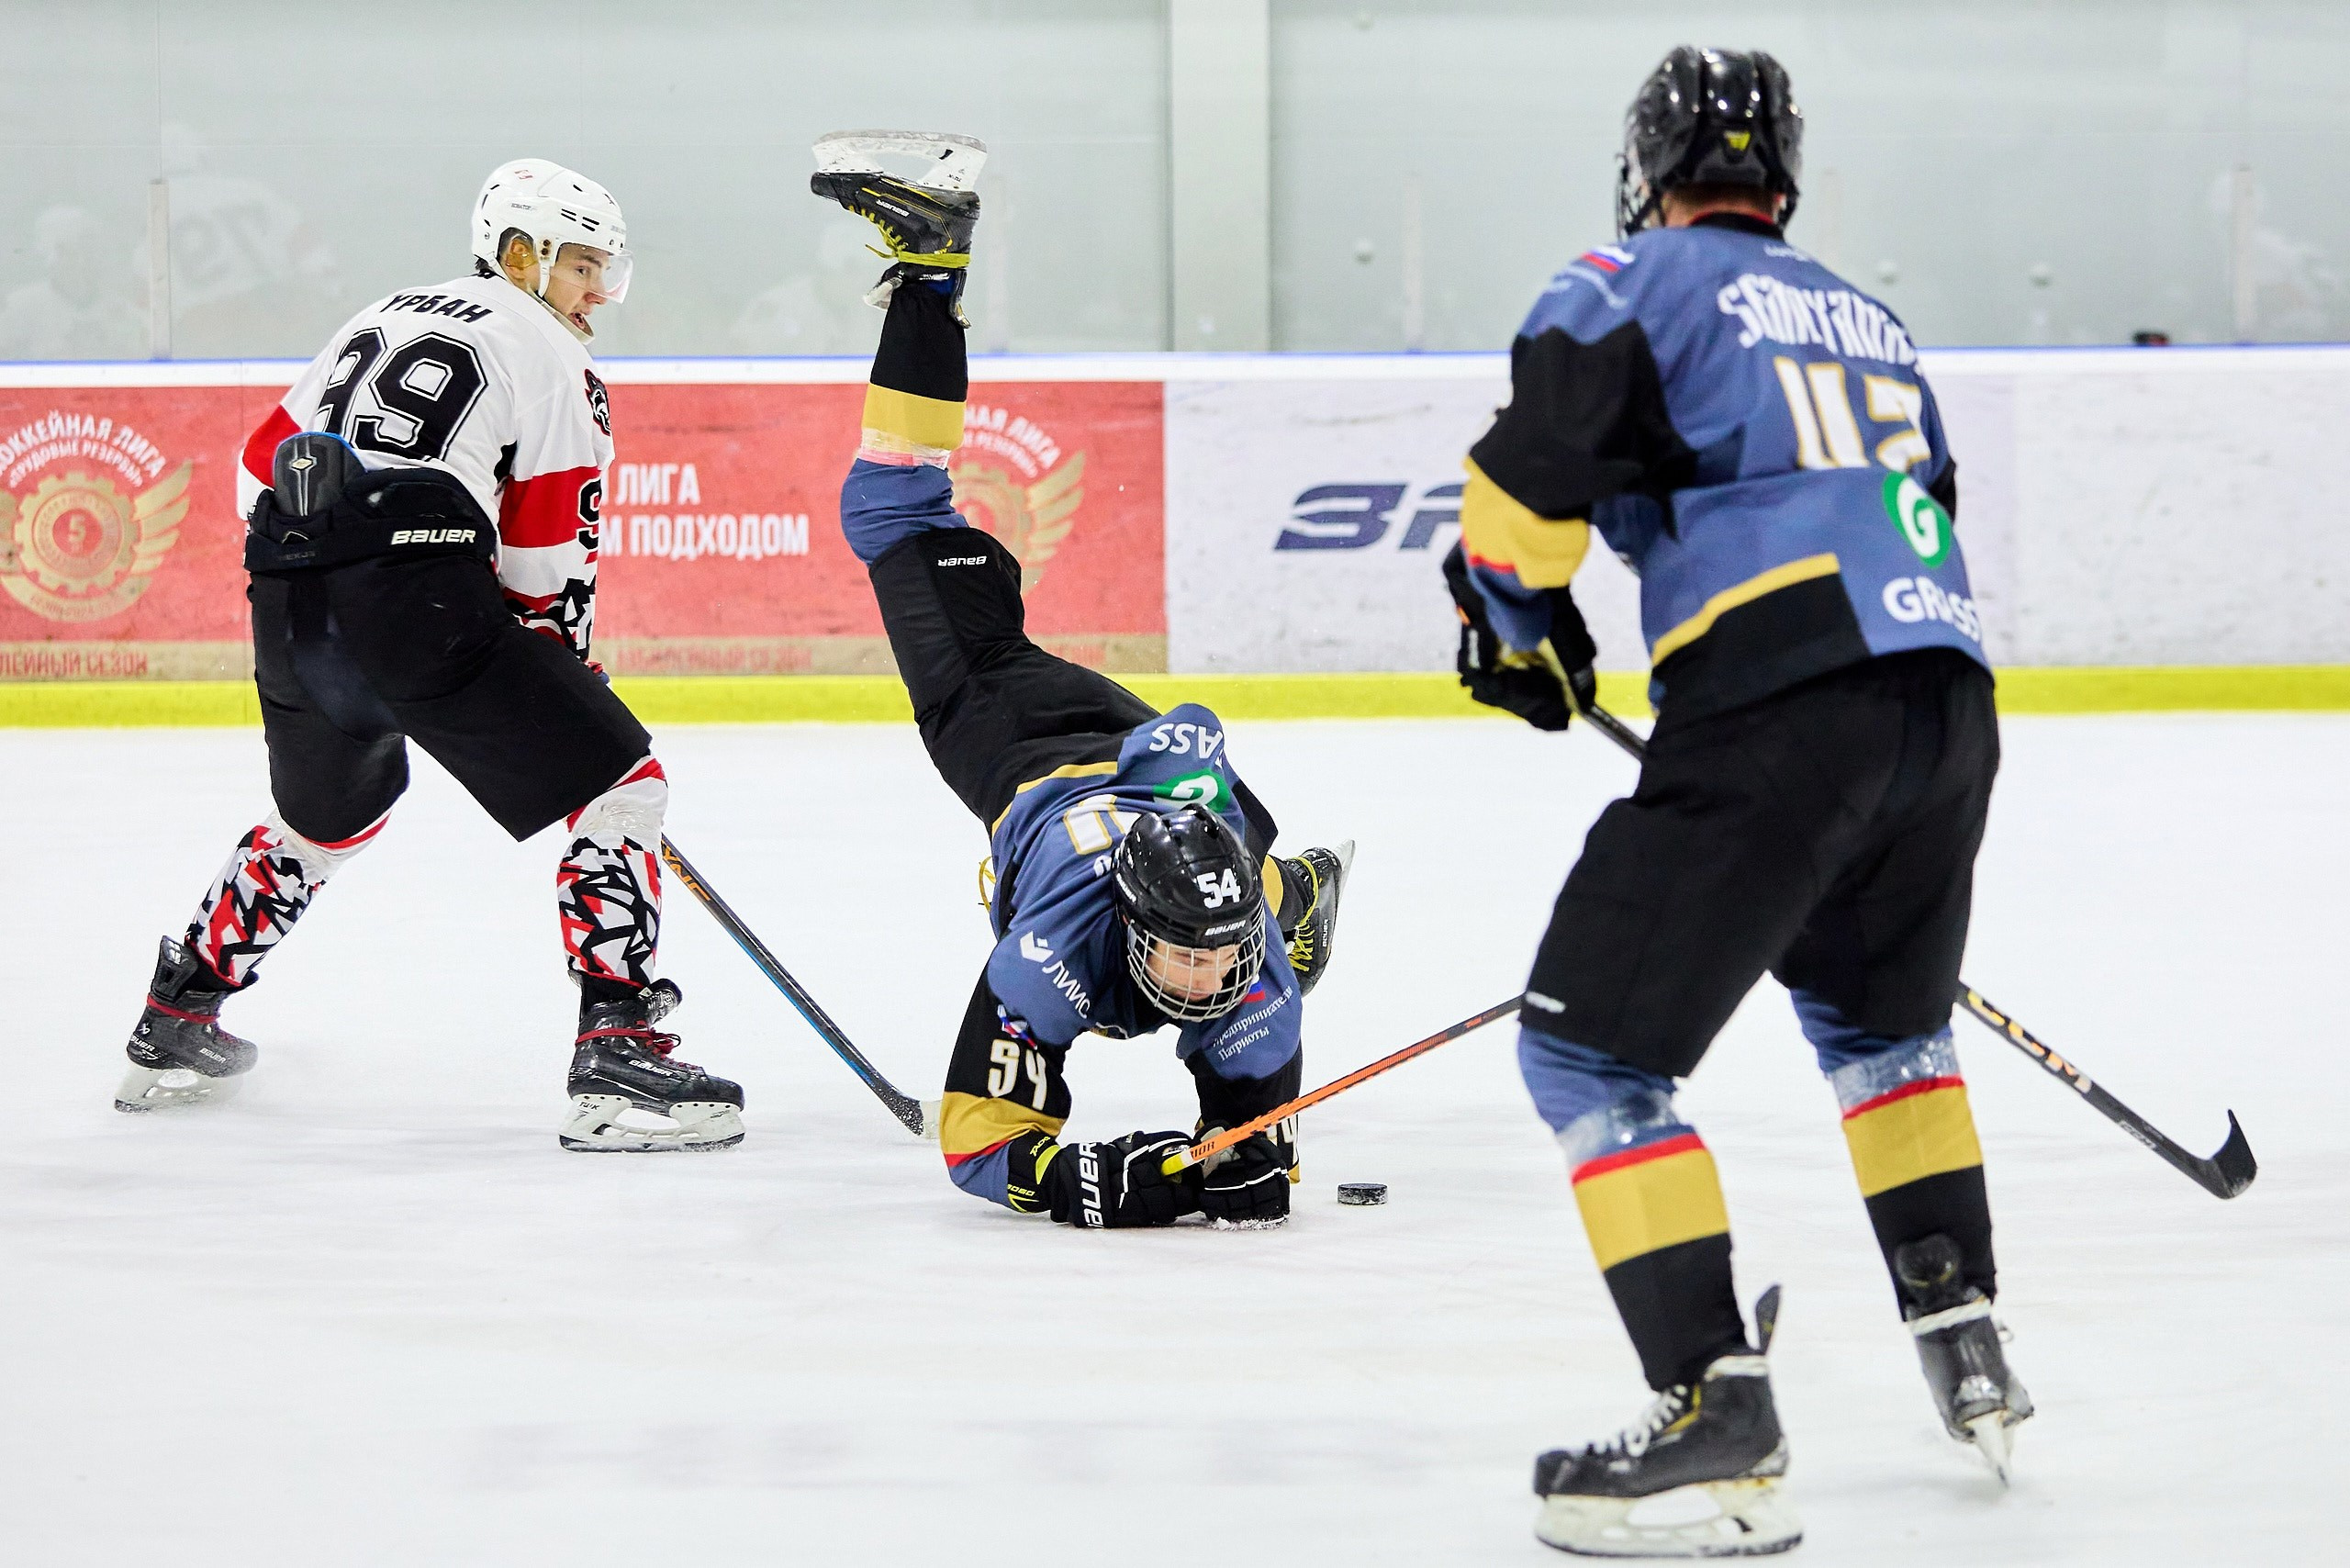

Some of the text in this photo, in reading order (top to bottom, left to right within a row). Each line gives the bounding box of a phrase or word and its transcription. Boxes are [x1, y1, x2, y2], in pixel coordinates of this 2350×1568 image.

[379, 295, 494, 323] УРБАН
[317, 327, 488, 462] 99
[0, 409, 166, 478] ОККЕЙНАЯ ЛИГА
[614, 463, 701, 506] ЛИГА
[391, 529, 476, 544] BAUER
[630, 513, 810, 562] ПОДХОДОМ
[937, 555, 987, 566] BAUER
[1148, 722, 1224, 769] ASS
[661, 839, 711, 902] YNC
[1196, 868, 1241, 909] 54
[1204, 919, 1247, 936] BAUER
[130, 1035, 155, 1052] AUER
[199, 1047, 226, 1064] BAUER
[1217, 1025, 1270, 1061] Патриоты
[629, 1059, 674, 1077] BAUER
[988, 1038, 1047, 1112] 54
[1079, 1143, 1104, 1228] AUER
